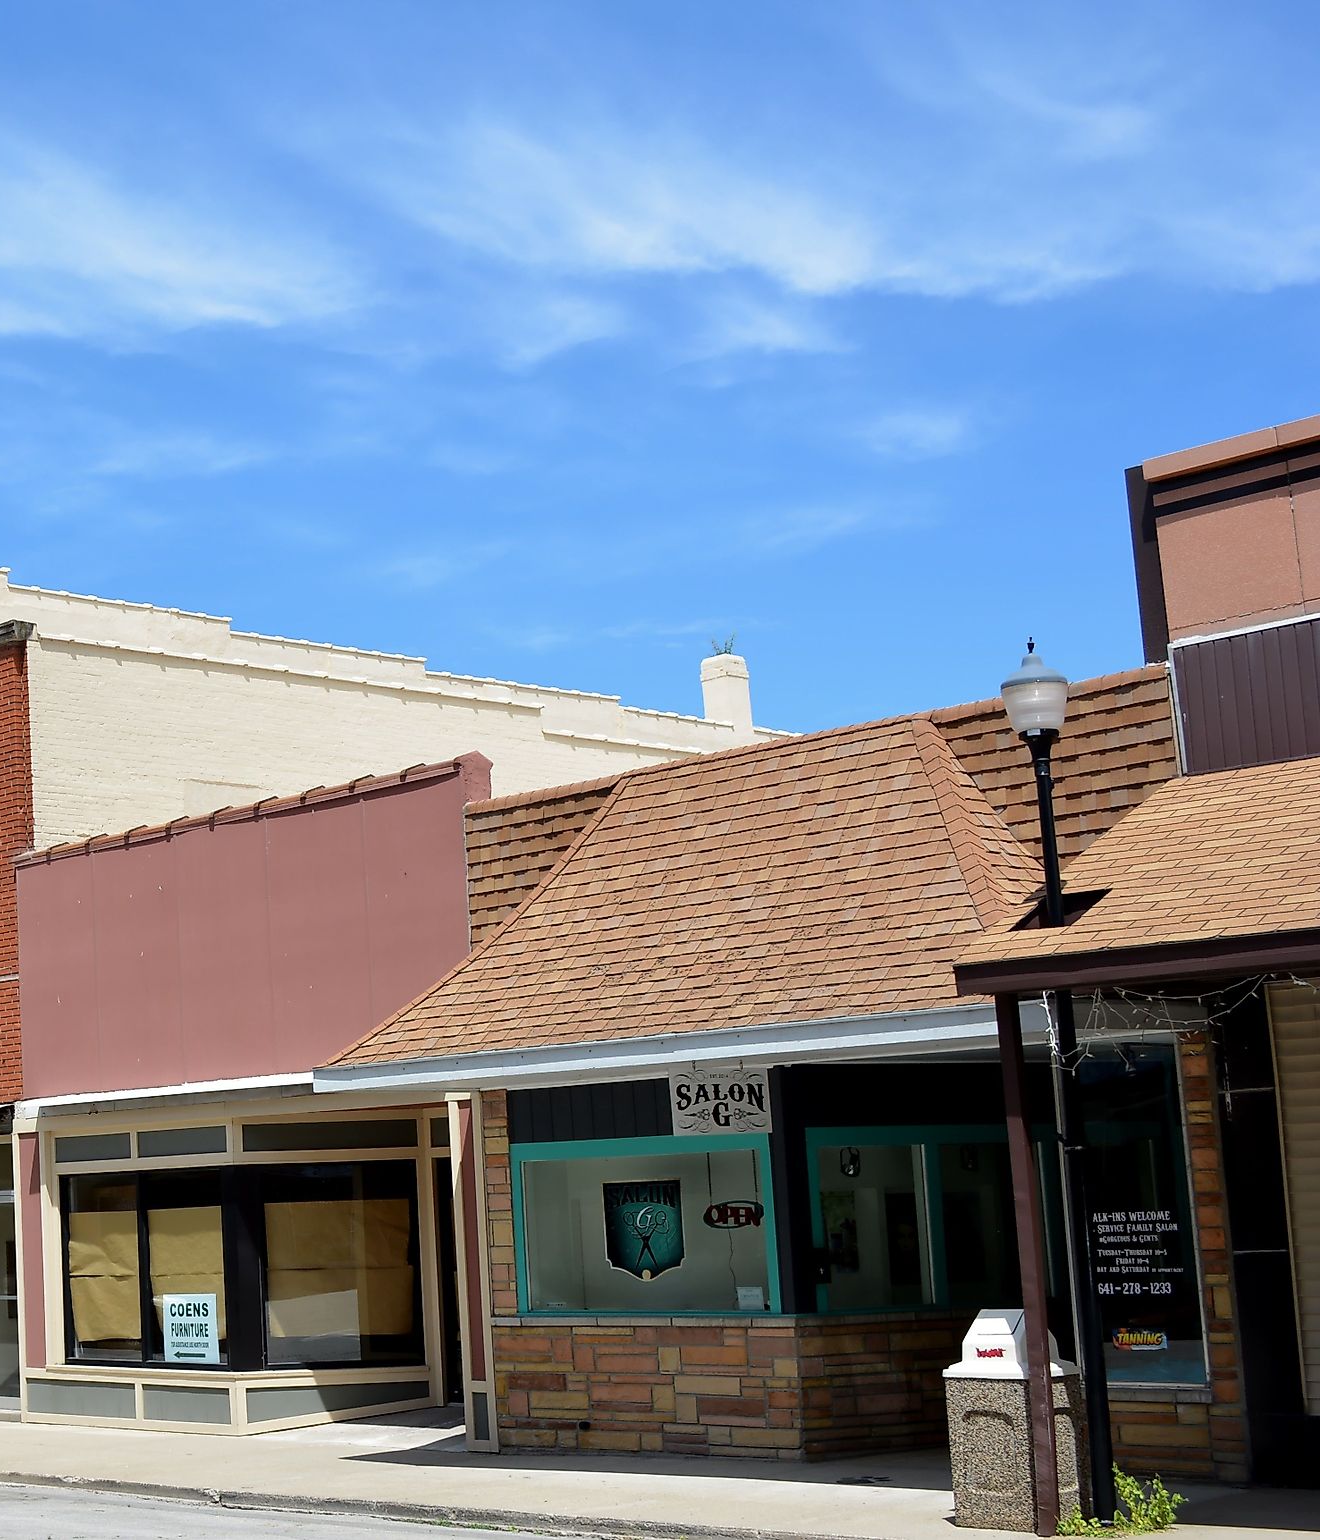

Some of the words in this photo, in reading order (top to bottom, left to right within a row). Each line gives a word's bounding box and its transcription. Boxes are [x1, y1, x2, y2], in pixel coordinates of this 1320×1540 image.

[676, 1083, 767, 1112] SALON
[711, 1102, 733, 1126] G
[637, 1206, 654, 1229] G
[707, 1204, 761, 1227] OPEN
[1092, 1211, 1126, 1222] ALK-INS
[1128, 1211, 1170, 1222] WELCOME
[1097, 1224, 1124, 1234] SERVICE
[1126, 1223, 1153, 1233] FAMILY
[1156, 1223, 1178, 1233] SALON
[1115, 1258, 1135, 1266] FRIDAY
[1121, 1266, 1150, 1274] SATURDAY
[1097, 1282, 1172, 1294] 641-278-1233
[170, 1303, 209, 1317] COENS
[171, 1323, 209, 1337] FURNITURE
[1117, 1332, 1162, 1345] TANNING
